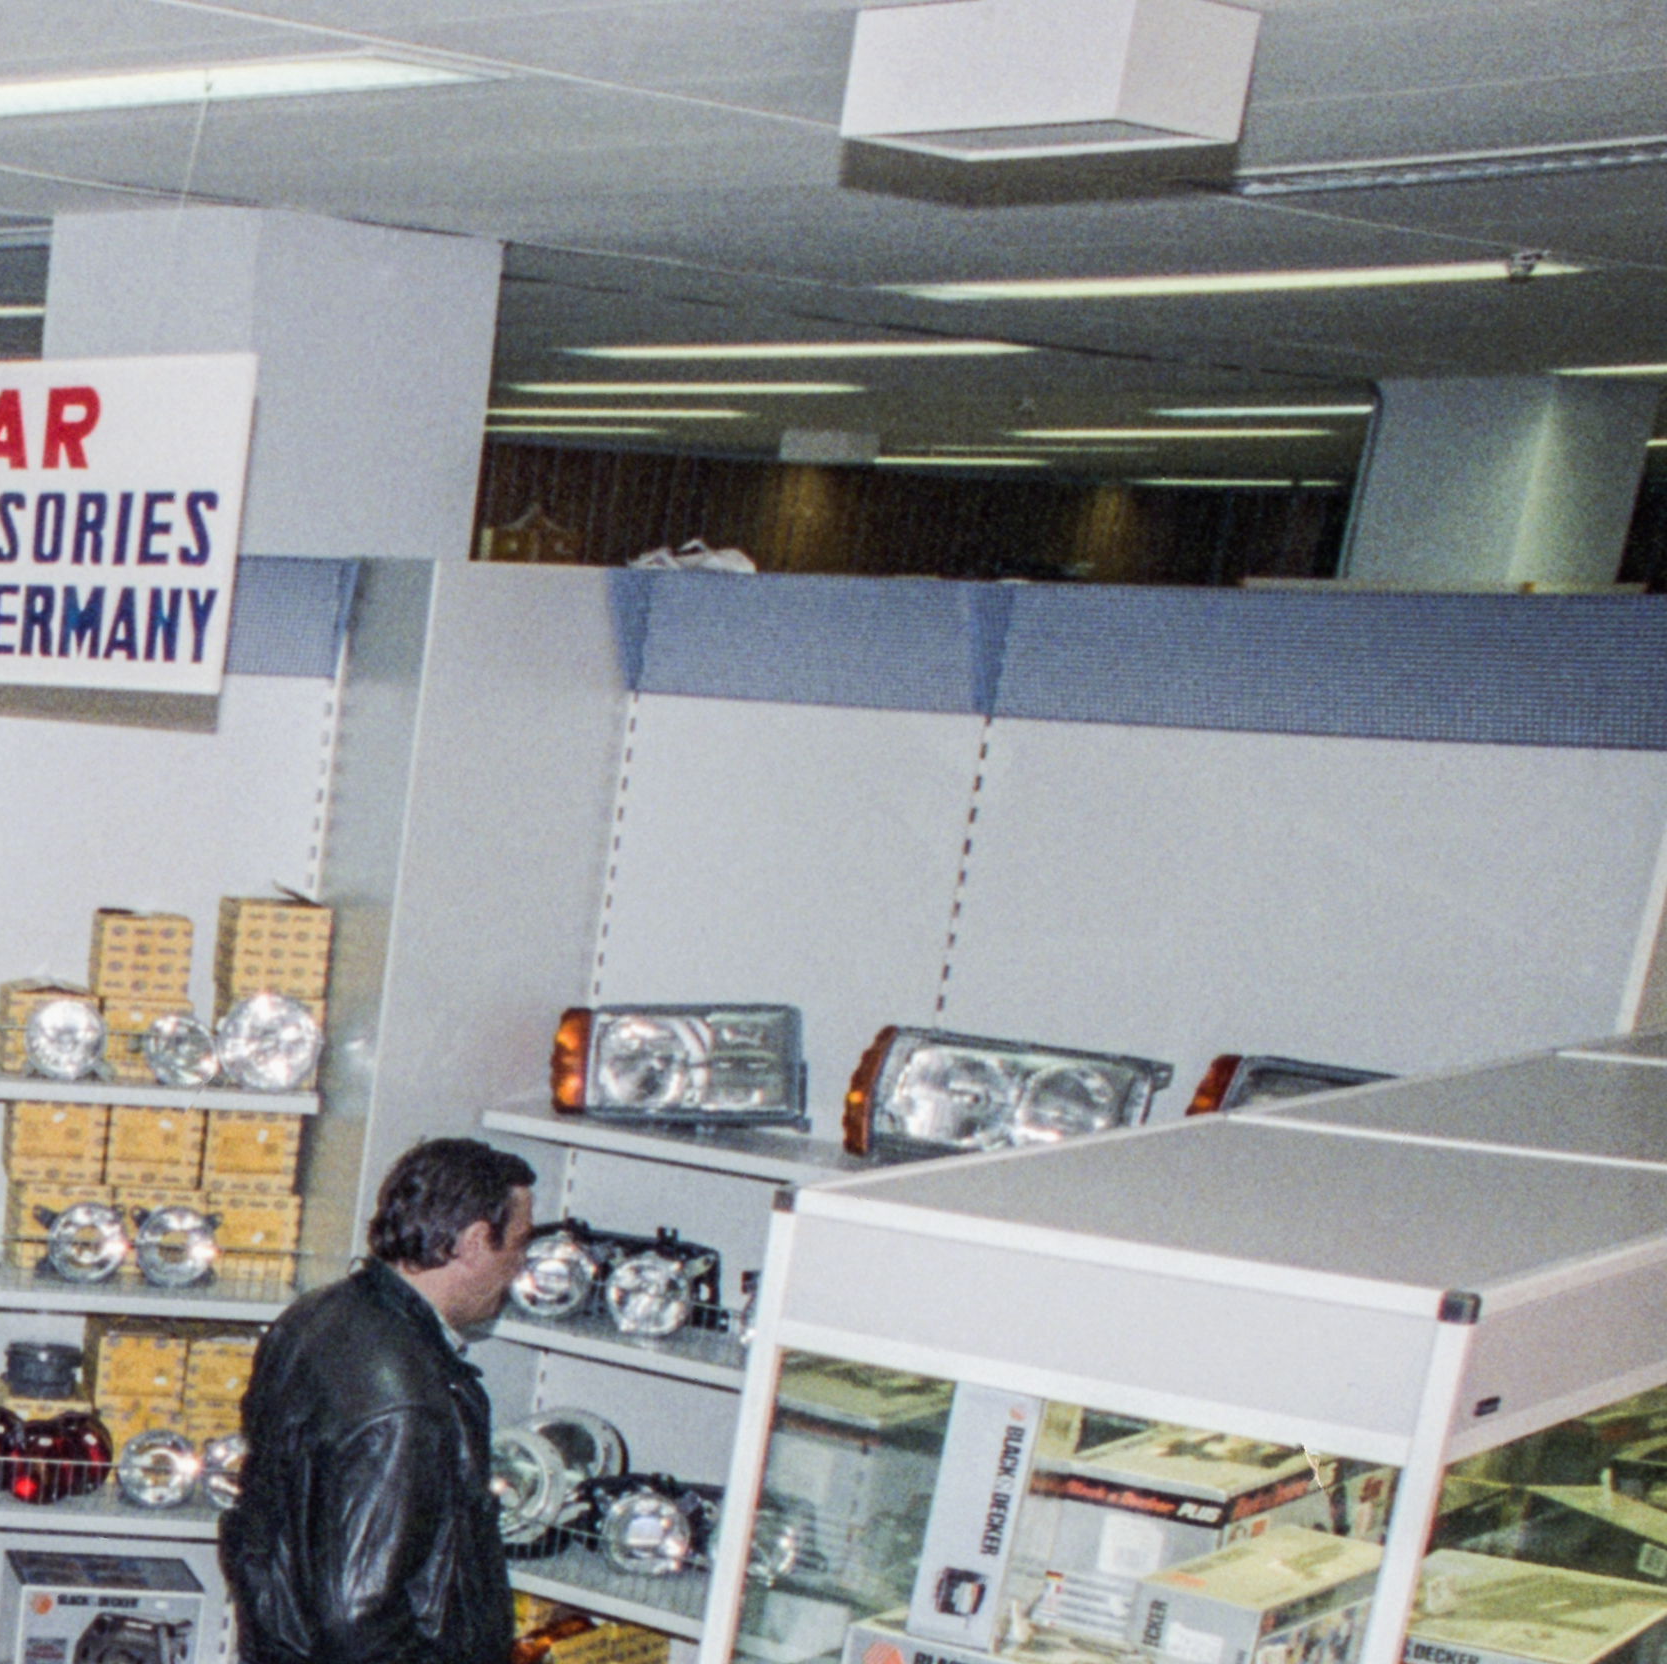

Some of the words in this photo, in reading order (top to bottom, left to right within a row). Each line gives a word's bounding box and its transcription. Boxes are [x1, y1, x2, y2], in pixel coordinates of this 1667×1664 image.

[996, 1425, 1025, 1479] BLACK
[979, 1491, 1012, 1557] DECKER
[1175, 1502, 1223, 1523] PLUS
[1143, 1599, 1167, 1648] ECKER
